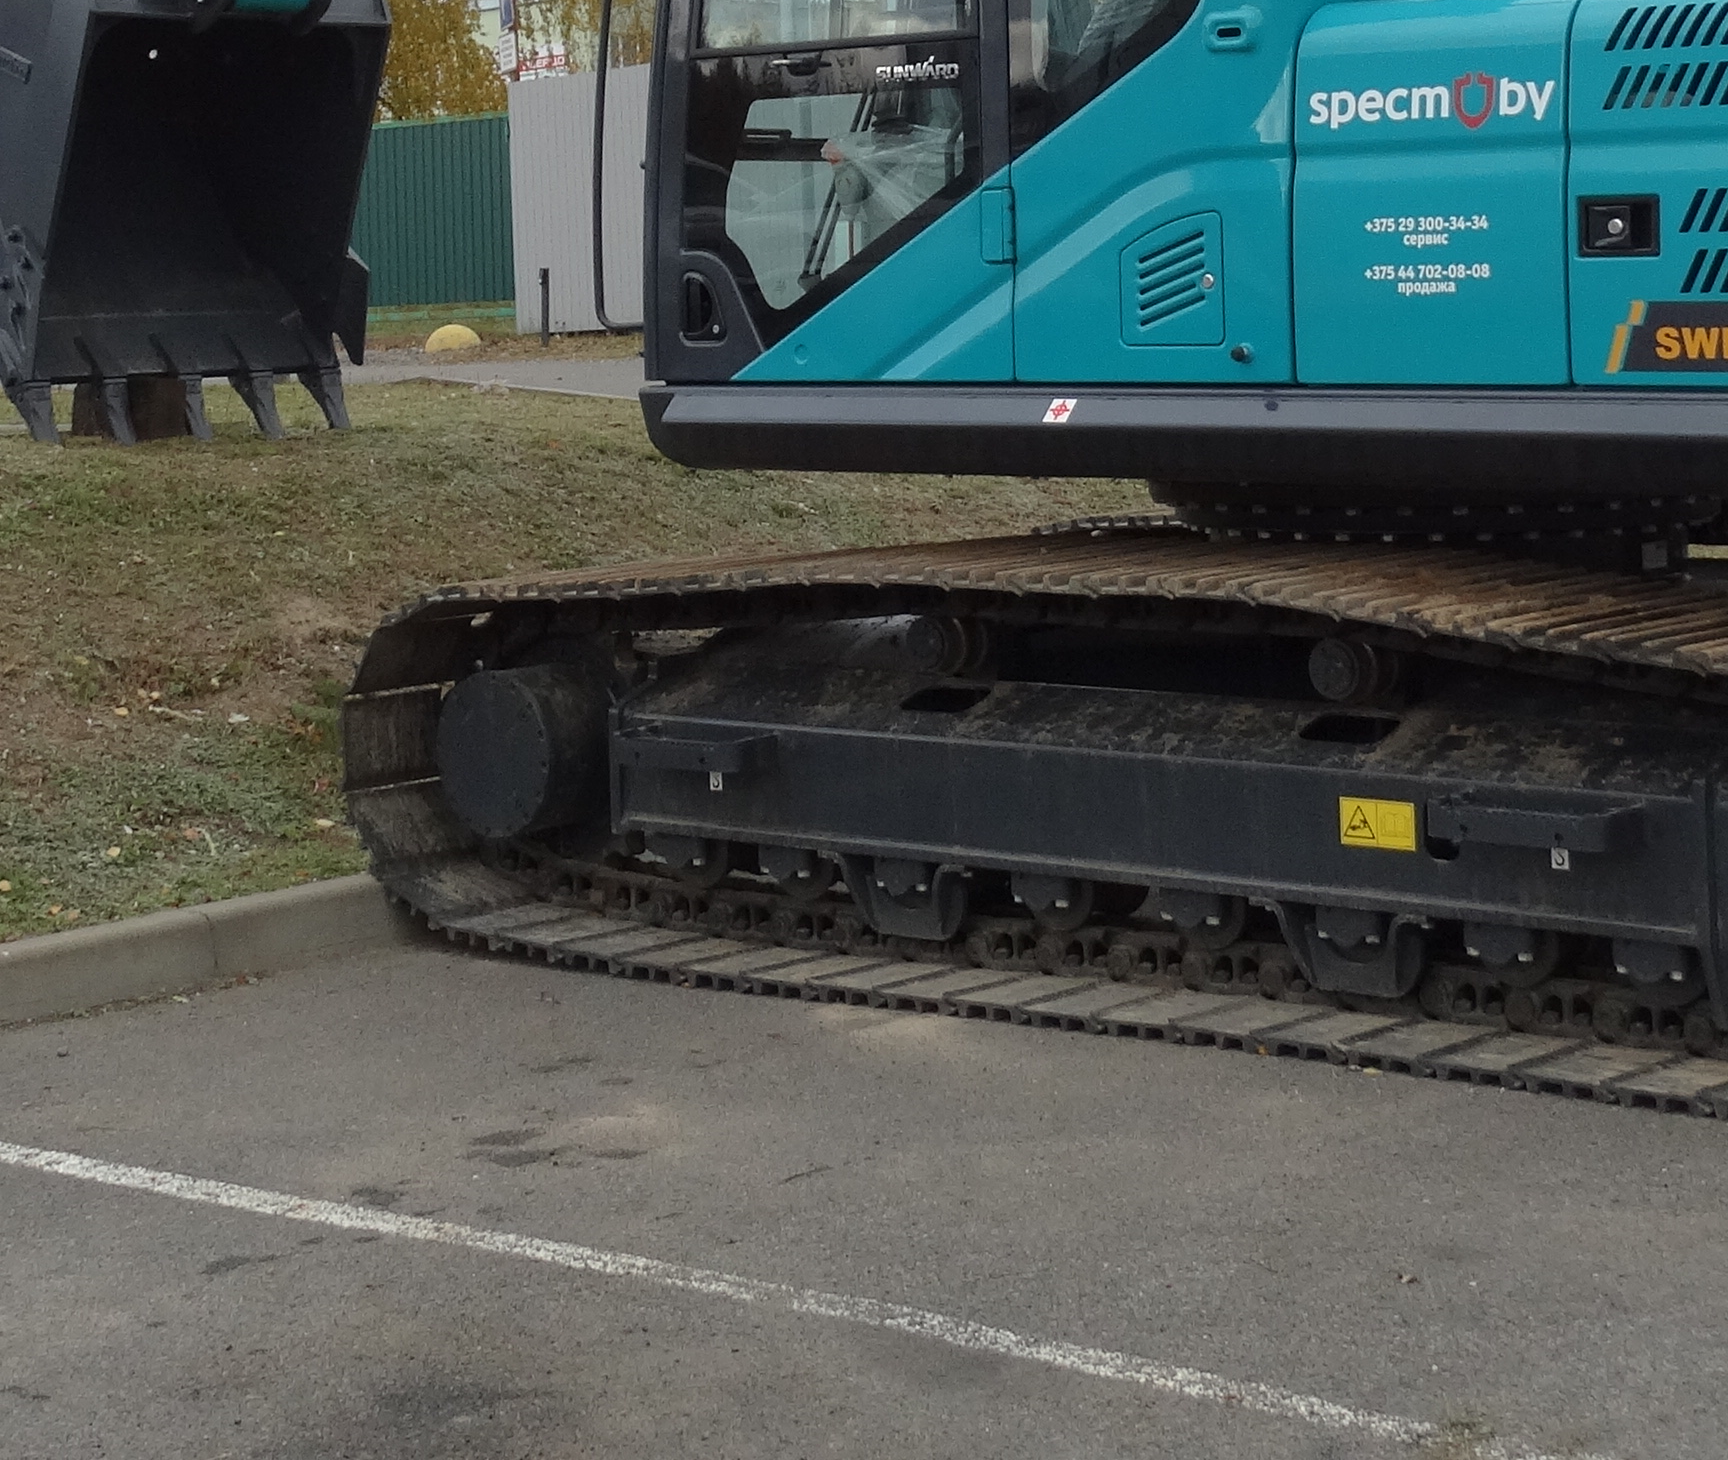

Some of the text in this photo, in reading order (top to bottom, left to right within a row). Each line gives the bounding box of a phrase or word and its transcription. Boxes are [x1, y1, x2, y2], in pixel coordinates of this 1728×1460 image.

[875, 55, 959, 81] SUNWARD
[1364, 215, 1489, 232] +375 29 300-34-34
[1403, 233, 1449, 248] сервис
[1364, 263, 1490, 279] +375 44 702-08-08
[1397, 281, 1456, 296] продажа
